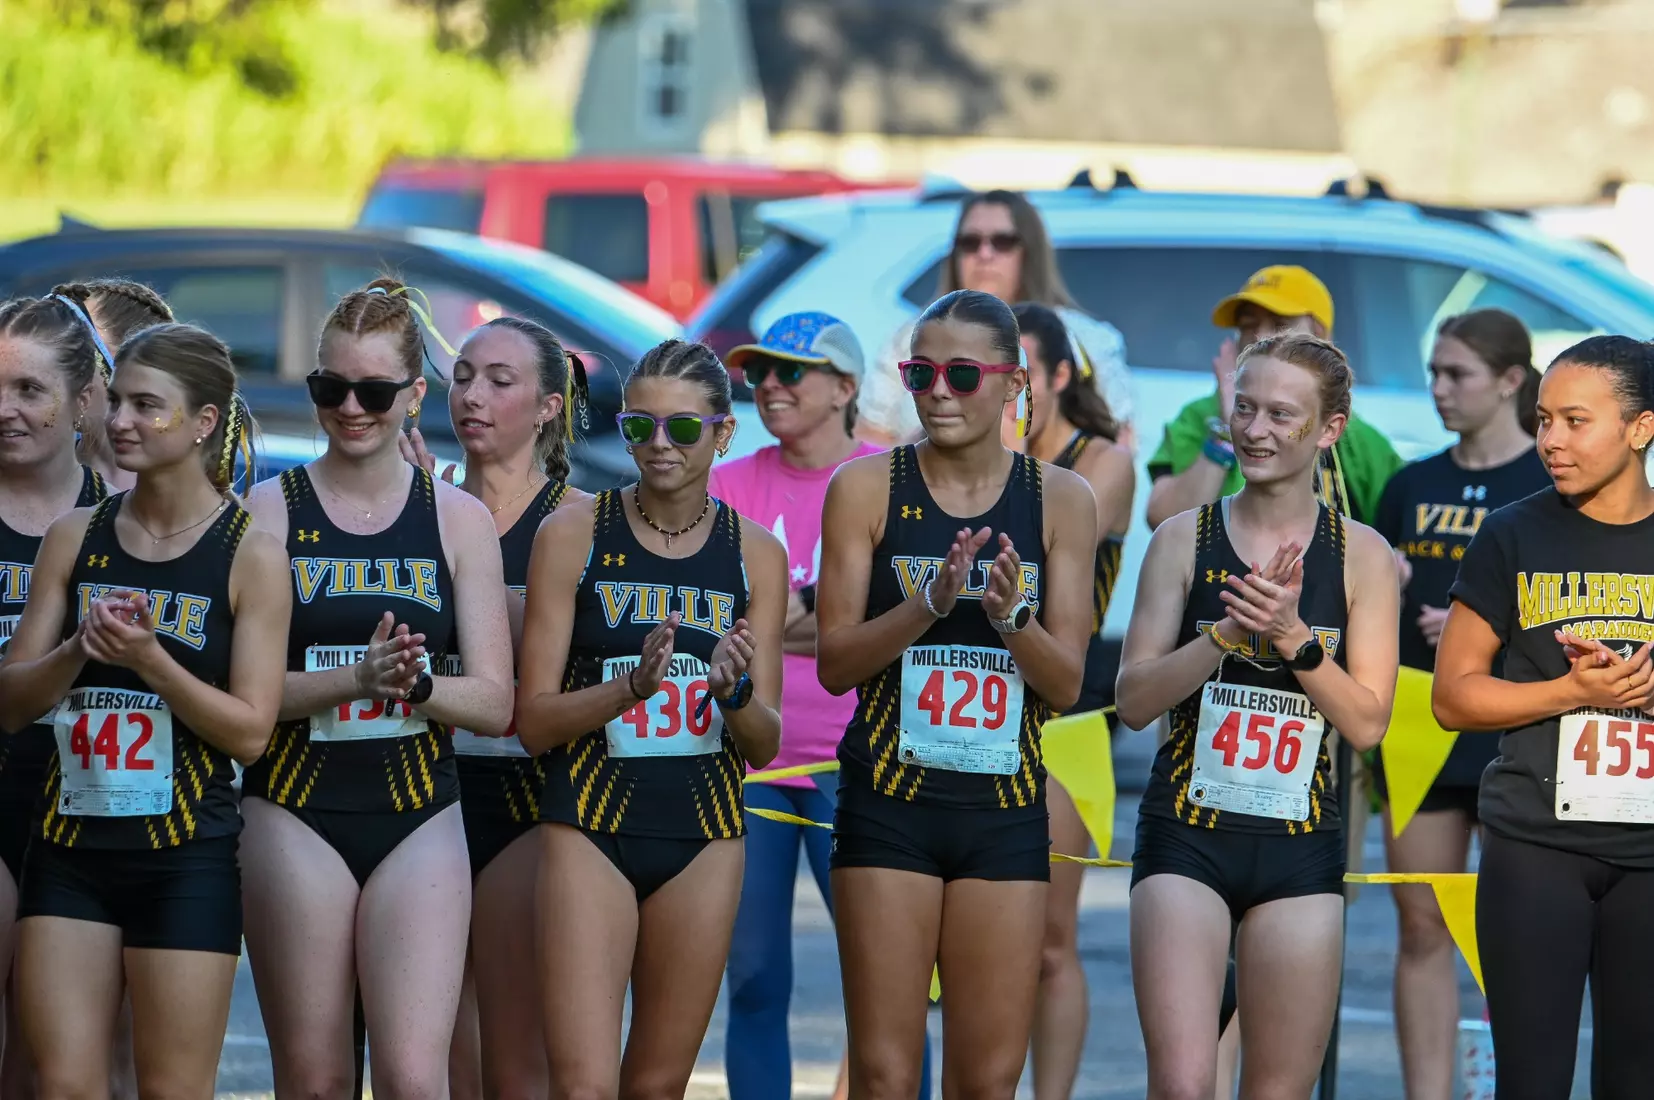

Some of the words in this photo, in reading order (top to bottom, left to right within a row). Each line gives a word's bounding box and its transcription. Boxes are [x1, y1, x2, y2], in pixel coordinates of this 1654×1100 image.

[1416, 503, 1489, 537] VILL
[1399, 540, 1445, 558] ACK
[291, 557, 442, 612] VILLE
[595, 581, 735, 639] VILLE
[78, 583, 211, 651] VLE
[1562, 620, 1654, 642] MARAUDE
[912, 649, 1016, 675] MILLERSVILLE
[67, 691, 164, 712] MILLERSVILLE
[621, 679, 713, 738] 436
[917, 669, 1008, 731] 429
[1211, 687, 1317, 720] MILLERSVILLE
[70, 712, 155, 770] 442
[1211, 710, 1306, 774] 456
[1573, 719, 1654, 780] 455
